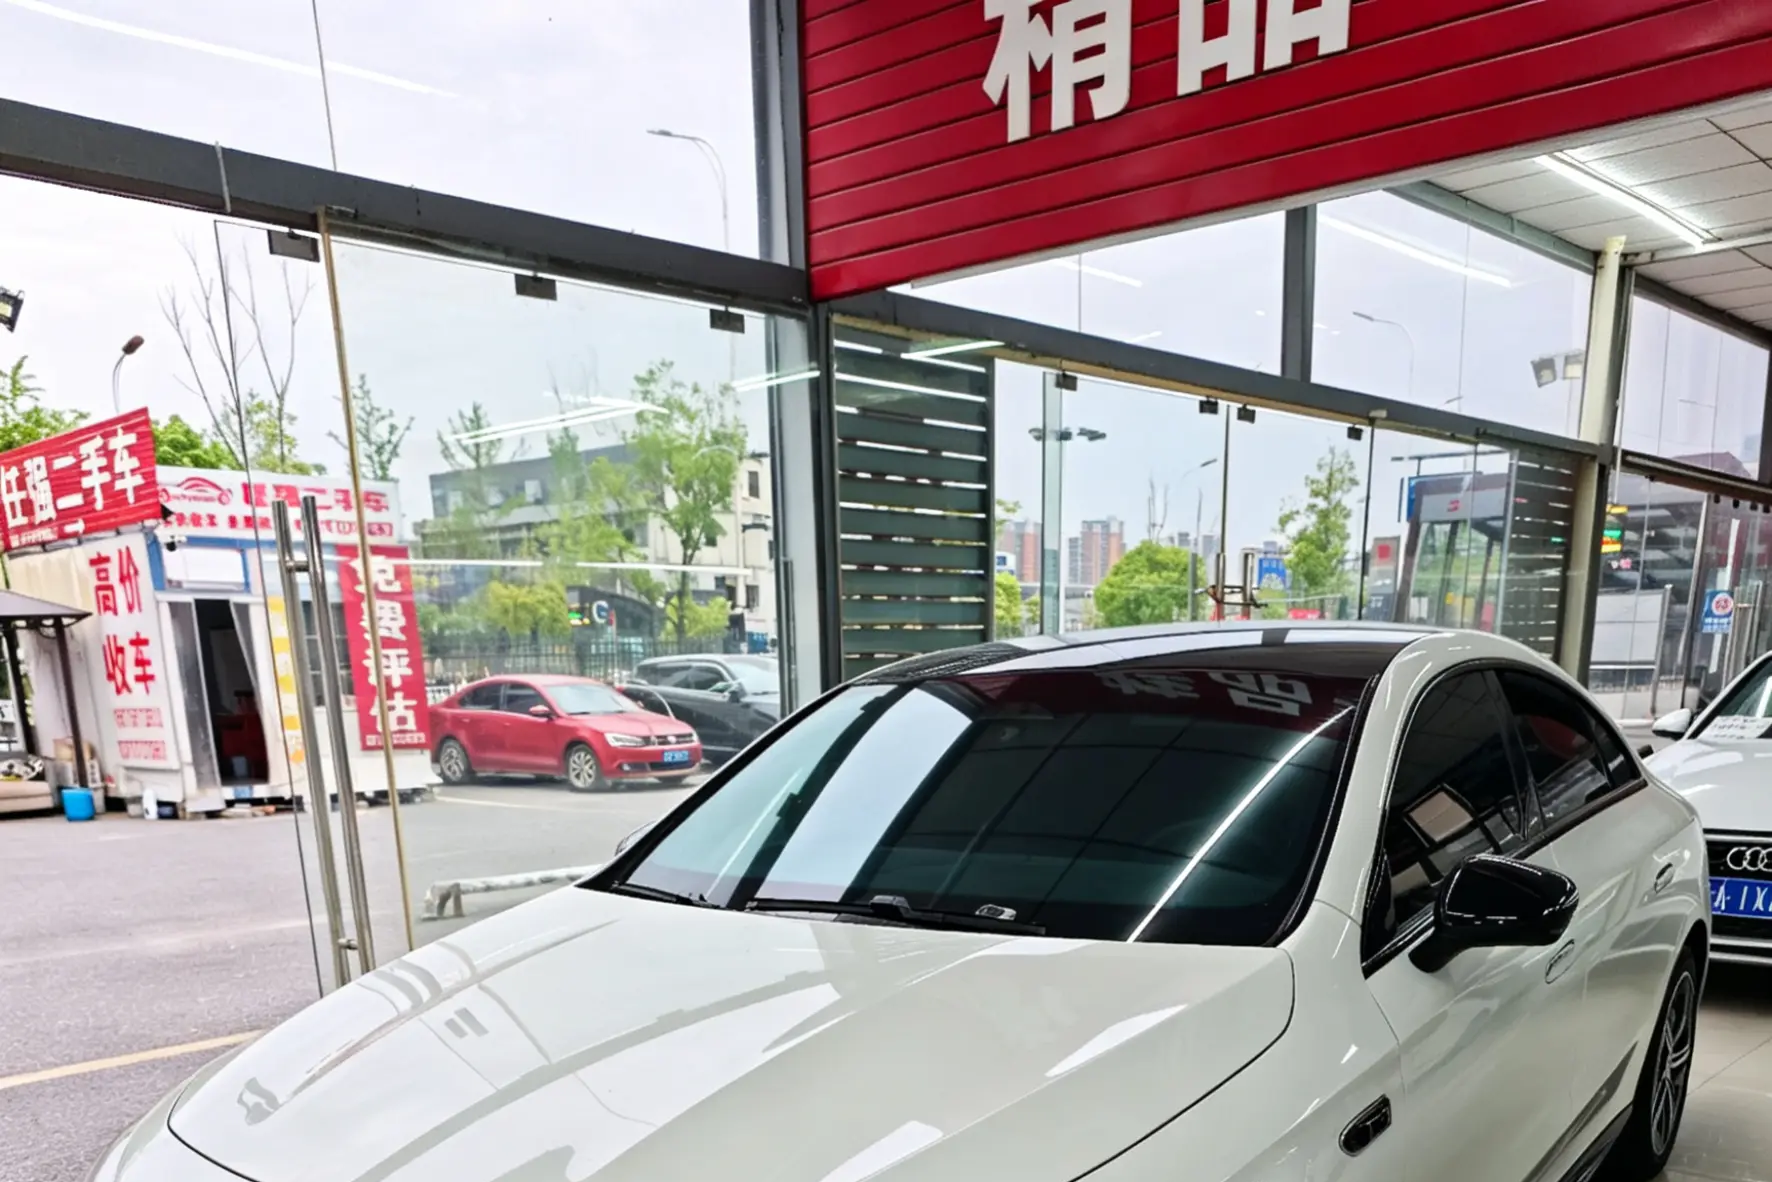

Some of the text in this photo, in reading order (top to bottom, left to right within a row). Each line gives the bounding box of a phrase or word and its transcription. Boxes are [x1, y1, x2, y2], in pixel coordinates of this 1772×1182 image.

[89, 546, 143, 616] 高价
[103, 631, 155, 696] 收车
[349, 555, 418, 733] 免费评估
